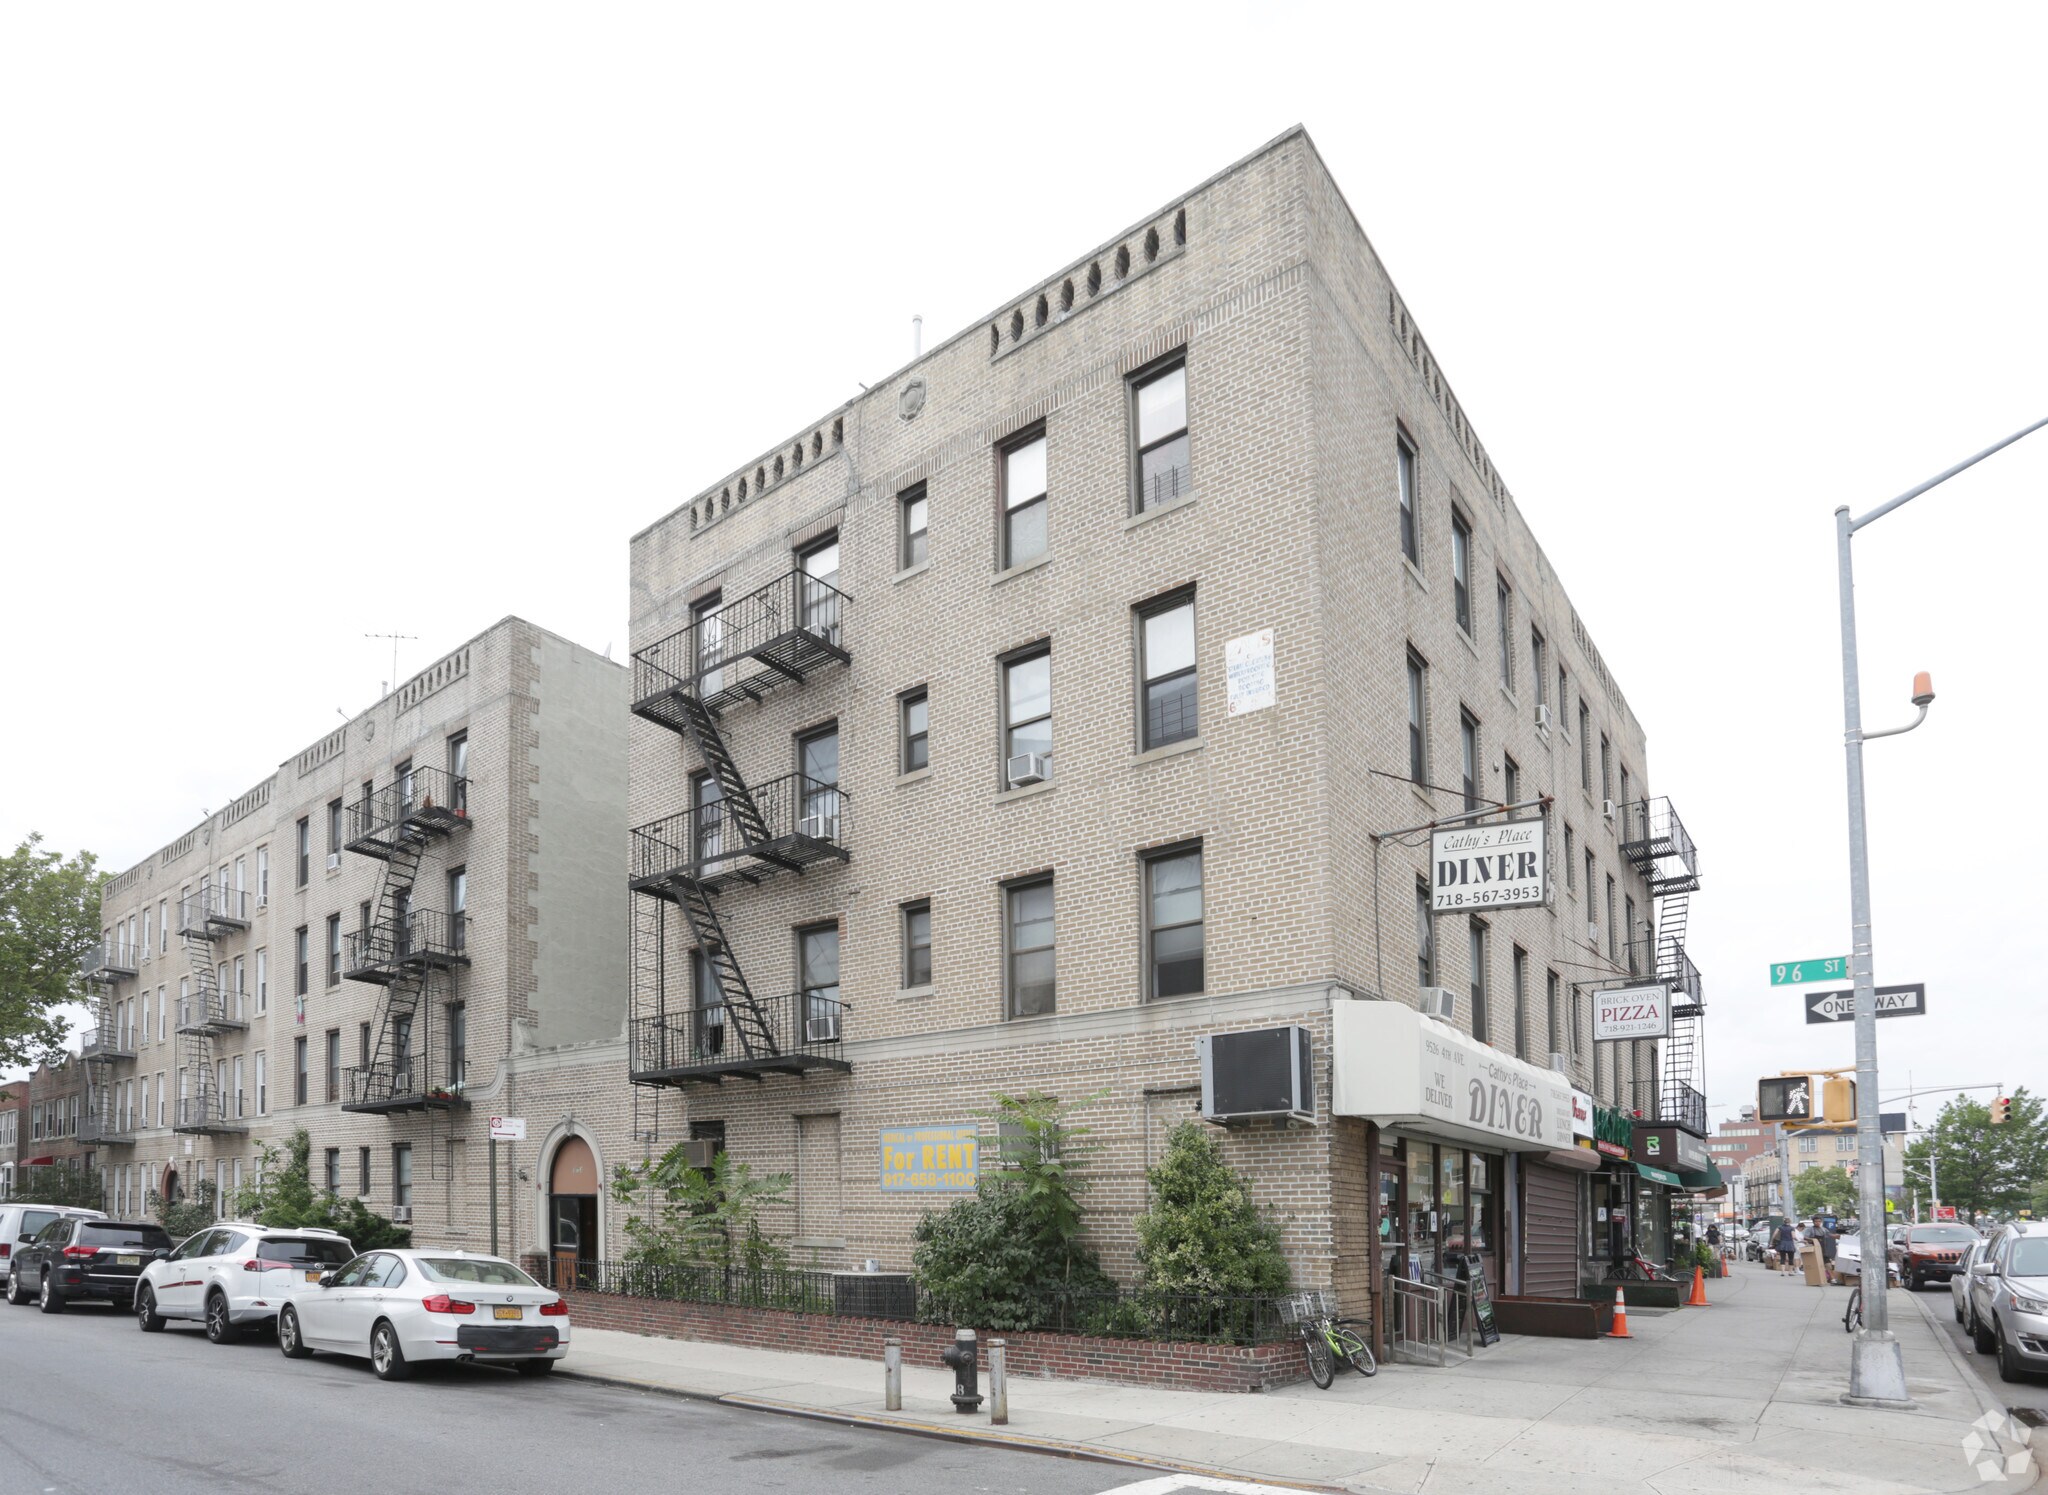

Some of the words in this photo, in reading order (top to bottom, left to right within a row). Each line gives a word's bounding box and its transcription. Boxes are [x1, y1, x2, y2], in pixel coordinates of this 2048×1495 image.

[1444, 831, 1490, 849] Cathy's
[1498, 829, 1532, 844] Place
[1437, 852, 1538, 887] DINER
[1436, 886, 1540, 907] 718-567-3953
[1776, 965, 1802, 983] 96
[1824, 959, 1840, 973] ST
[1601, 995, 1629, 1005] BRICK
[1631, 993, 1659, 1002] OVEN
[1823, 999, 1854, 1014] ONE
[1874, 994, 1908, 1010] WAY
[1601, 1004, 1659, 1023] PIZZA
[1604, 1022, 1656, 1033] 718-921-1246
[1453, 1051, 1465, 1067] AVE
[1434, 1072, 1445, 1089] WE
[1488, 1063, 1512, 1086] Cathy's
[1512, 1072, 1528, 1091] Place
[1425, 1087, 1453, 1109] DELIVER
[1468, 1078, 1543, 1140] DINER
[883, 1146, 915, 1171] For
[922, 1143, 976, 1170] RENT
